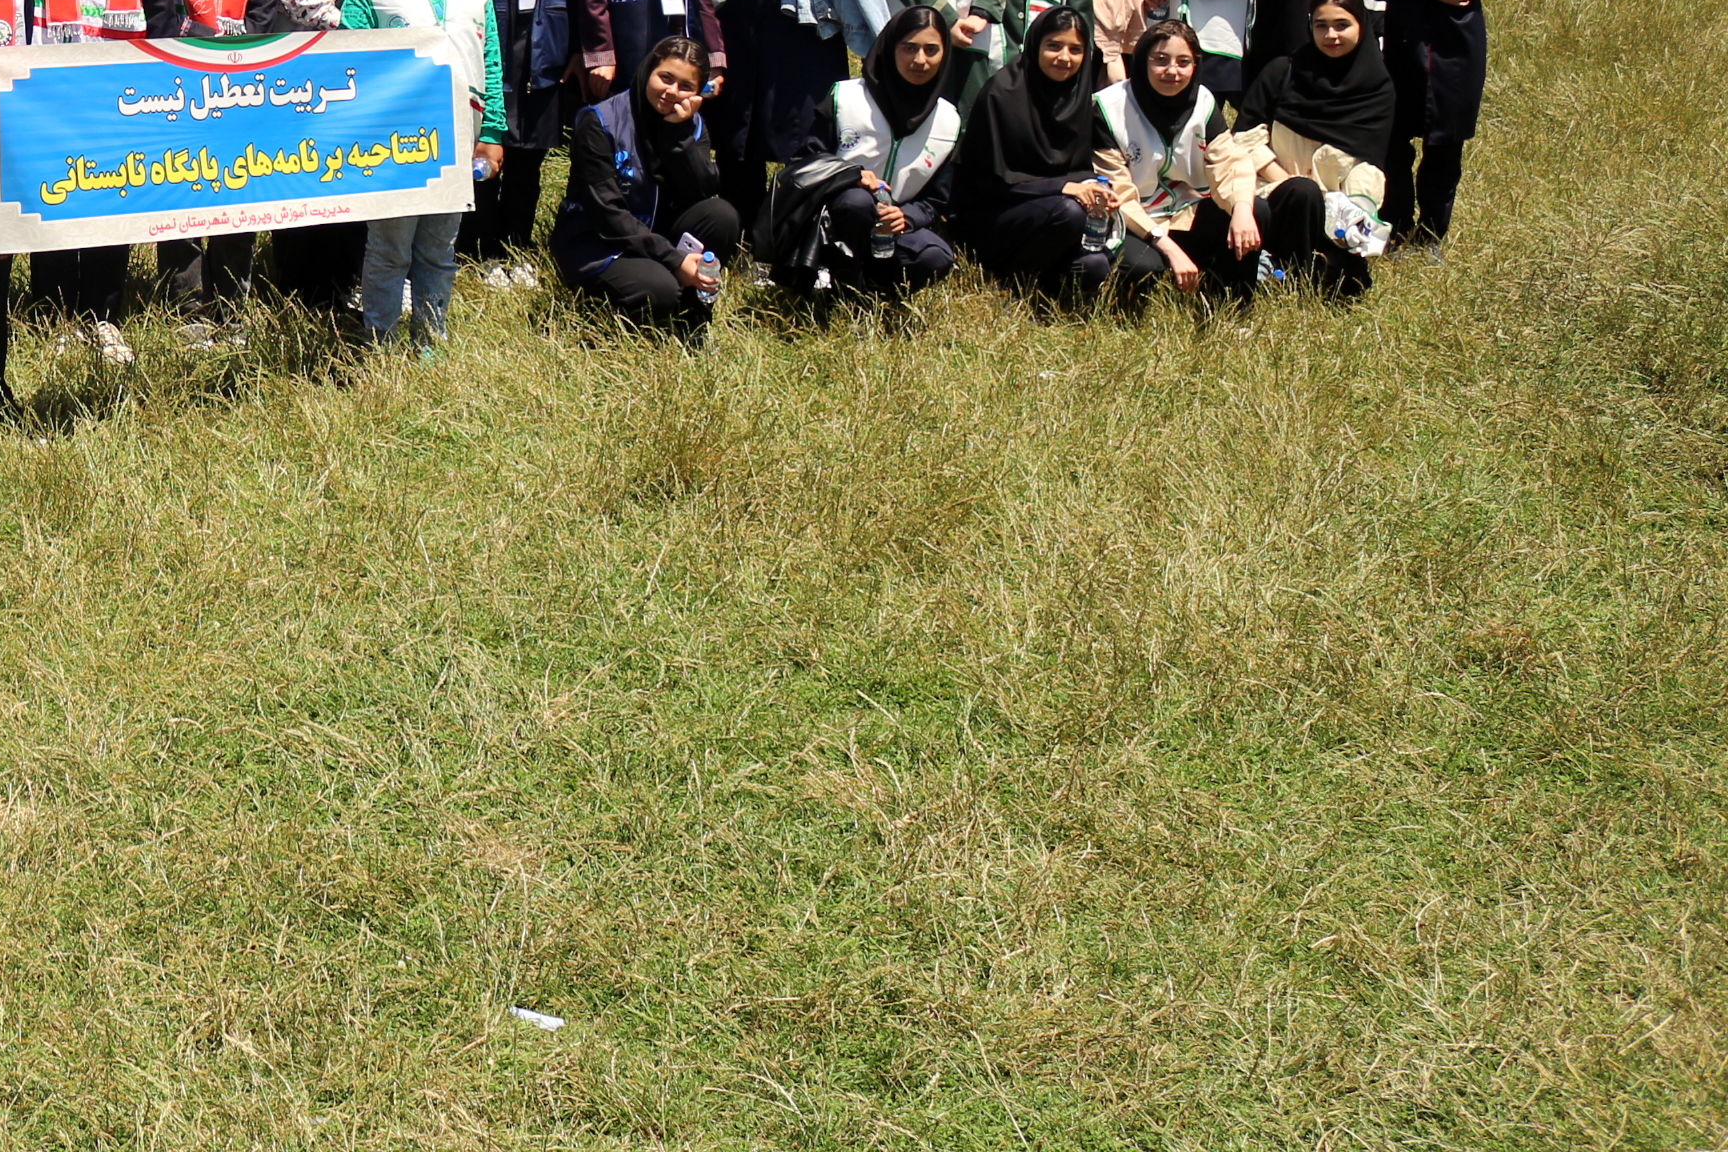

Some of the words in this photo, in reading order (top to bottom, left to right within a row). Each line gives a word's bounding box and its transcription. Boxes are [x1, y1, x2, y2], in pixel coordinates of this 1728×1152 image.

[117, 75, 185, 122] نیست
[189, 73, 266, 121] تعطیل
[269, 67, 357, 114] تربیت
[150, 145, 221, 194] پایگاه
[347, 126, 439, 178] افتتاحیه
[39, 150, 147, 205] تابستانی
[148, 217, 177, 237] نمین
[178, 211, 231, 234] شهرستان
[273, 203, 308, 225] آموزش
[309, 204, 351, 218] مدیریت
